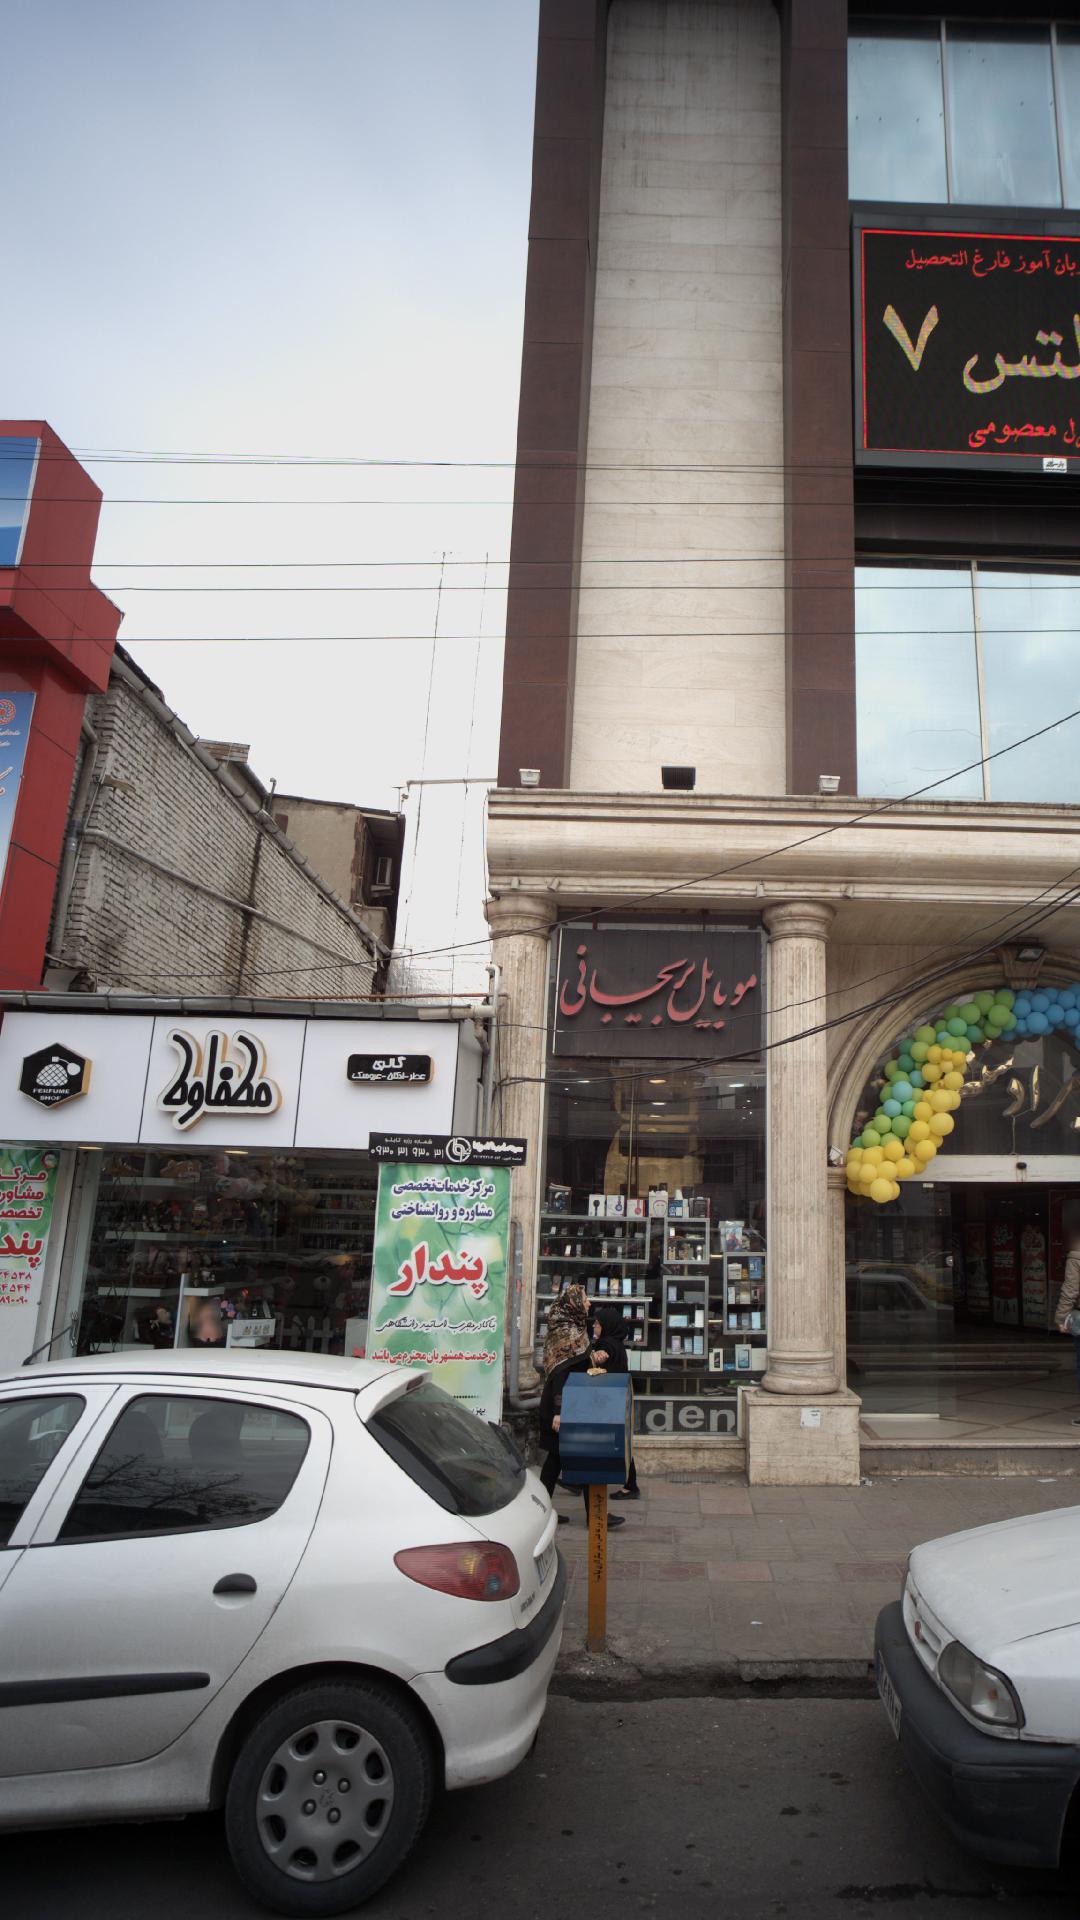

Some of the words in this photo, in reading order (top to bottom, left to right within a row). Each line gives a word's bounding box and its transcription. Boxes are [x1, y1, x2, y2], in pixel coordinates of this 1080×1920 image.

[905, 249, 968, 270] التحصیل
[972, 249, 1011, 277] فارغ
[1014, 248, 1051, 274] آموز
[883, 304, 940, 371] ۷
[968, 422, 1056, 448] معصومی
[668, 957, 757, 1029] موبایل
[393, 1177, 436, 1195] تخصصی
[436, 1178, 470, 1193] خدمات
[470, 1179, 494, 1198] مرکز
[391, 1202, 450, 1220] روانشناختی
[451, 1209, 458, 1220] و
[458, 1204, 493, 1221] مشاوره
[389, 1243, 484, 1295] پندار
[645, 1401, 736, 1432] den
